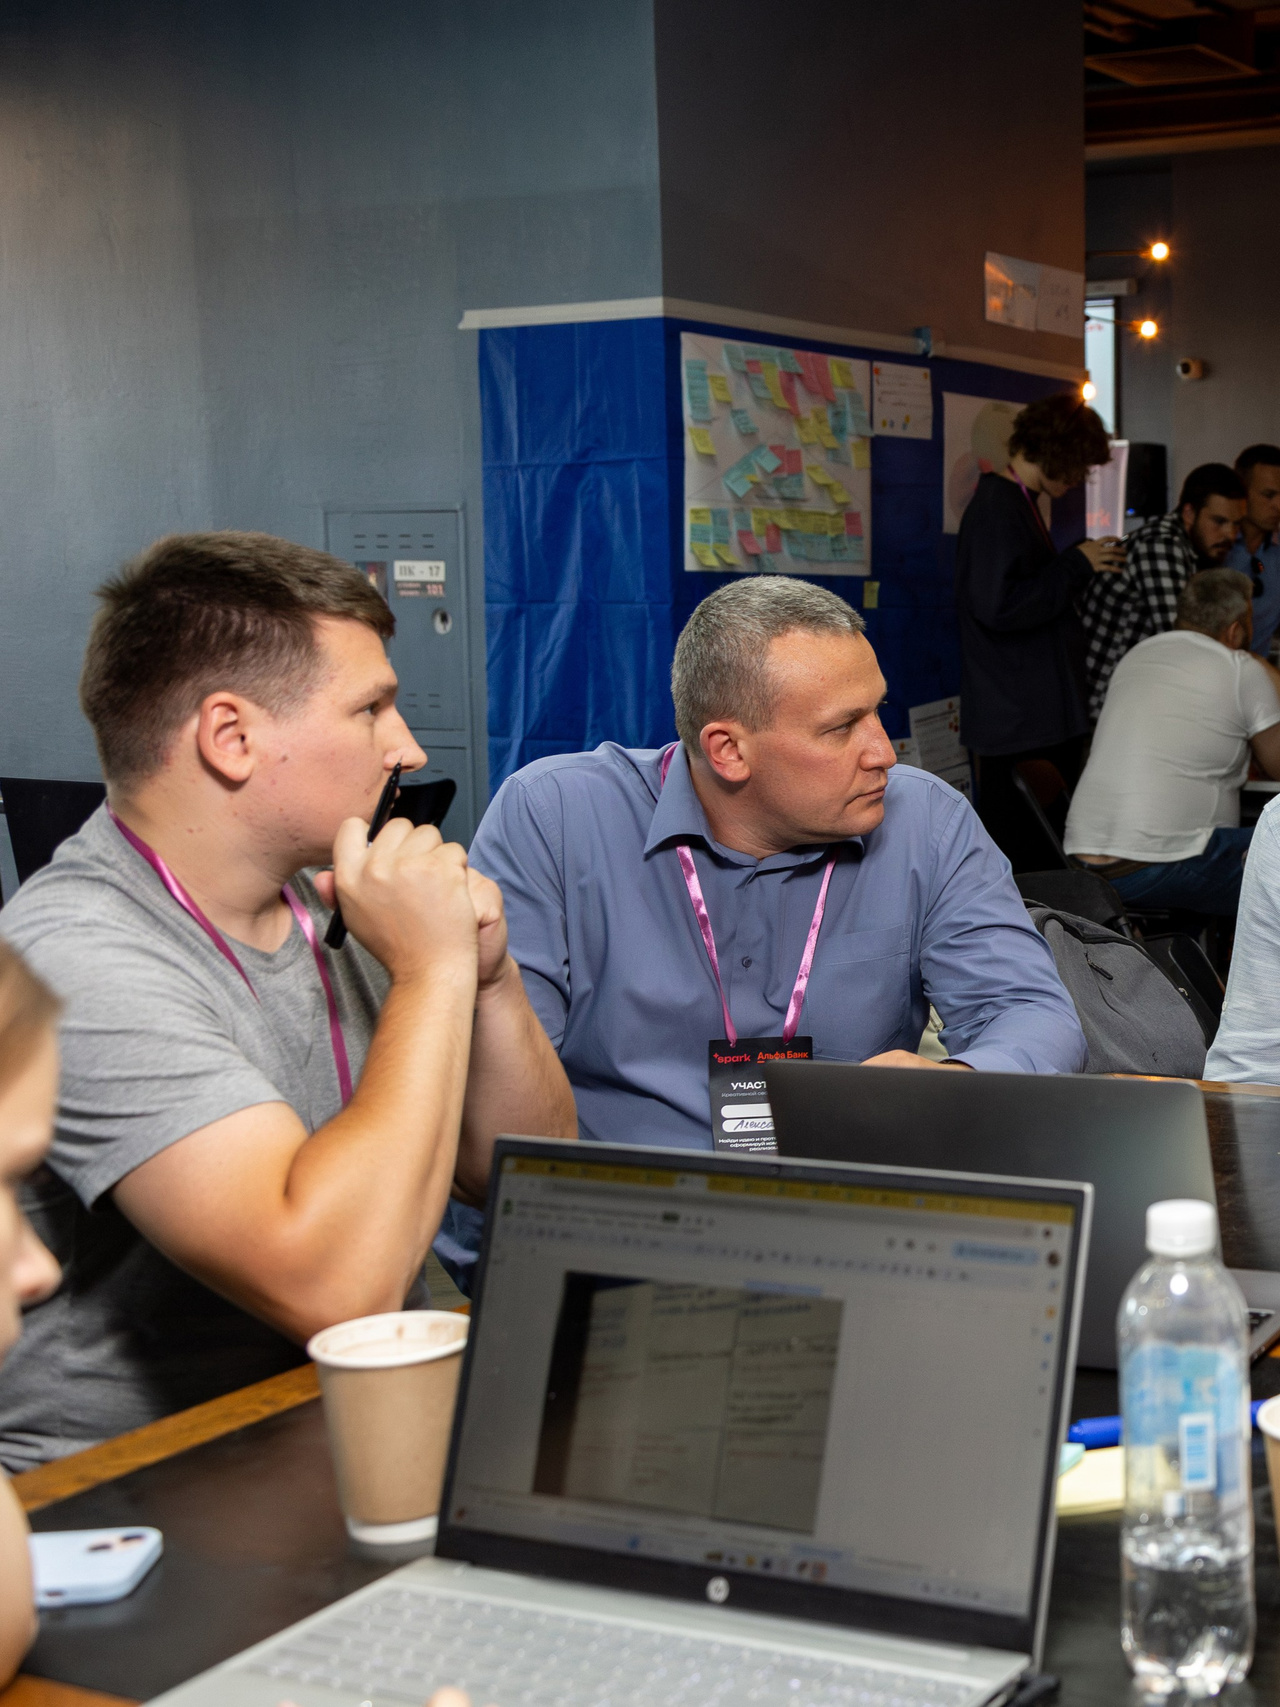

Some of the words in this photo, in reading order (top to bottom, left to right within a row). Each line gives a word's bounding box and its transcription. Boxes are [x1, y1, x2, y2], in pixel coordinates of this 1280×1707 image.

[428, 565, 440, 577] 17
[757, 1051, 786, 1061] Альфа
[786, 1050, 809, 1059] Банк
[730, 1081, 767, 1090] УЧАСТ
[733, 1119, 774, 1131] Алекса
